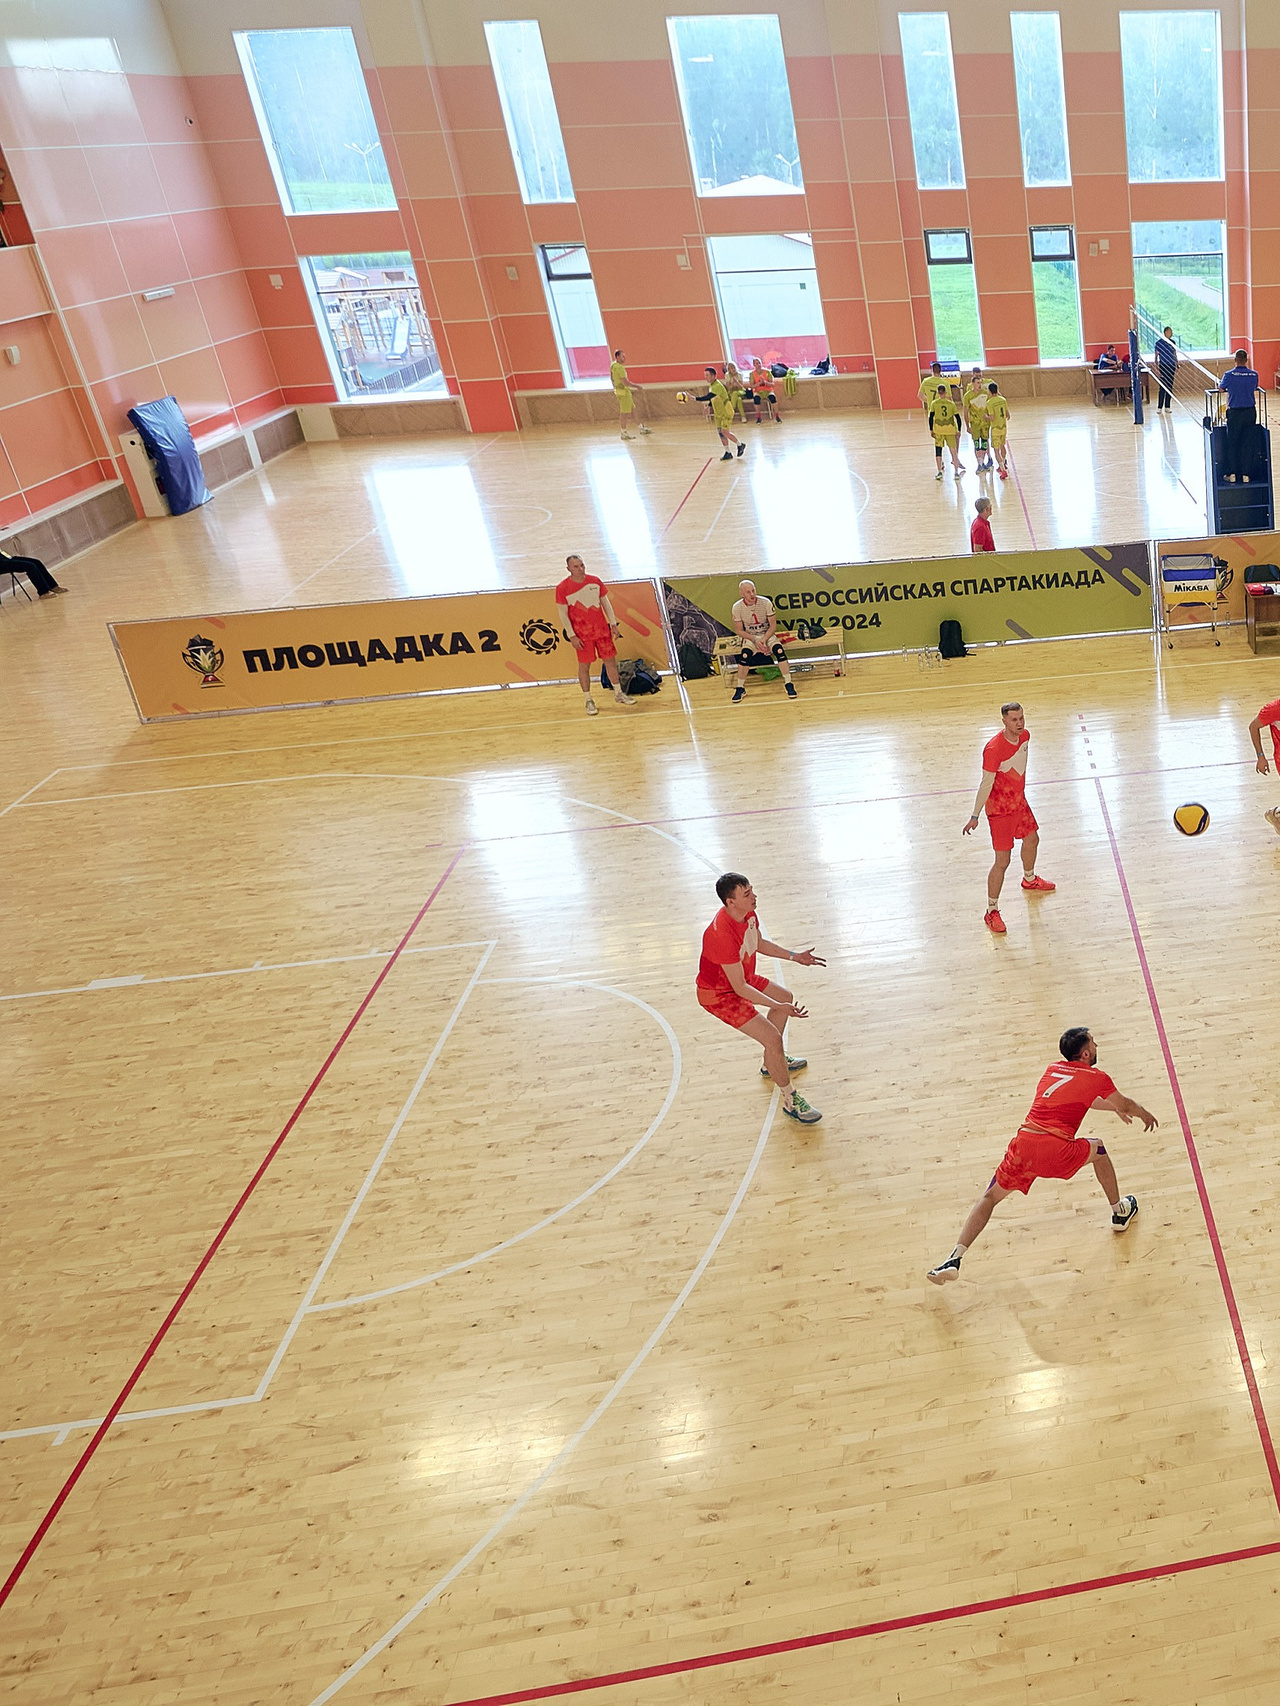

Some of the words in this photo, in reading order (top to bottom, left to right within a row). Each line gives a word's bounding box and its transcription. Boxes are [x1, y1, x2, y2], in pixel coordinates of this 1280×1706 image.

[941, 405, 947, 417] 3
[950, 569, 1105, 596] СПАРТАКИАДА
[752, 613, 760, 625] 1
[829, 612, 882, 630] 2024
[242, 632, 476, 673] ПЛОЩАДКА
[478, 629, 502, 653] 2
[1042, 1072, 1074, 1098] 7
